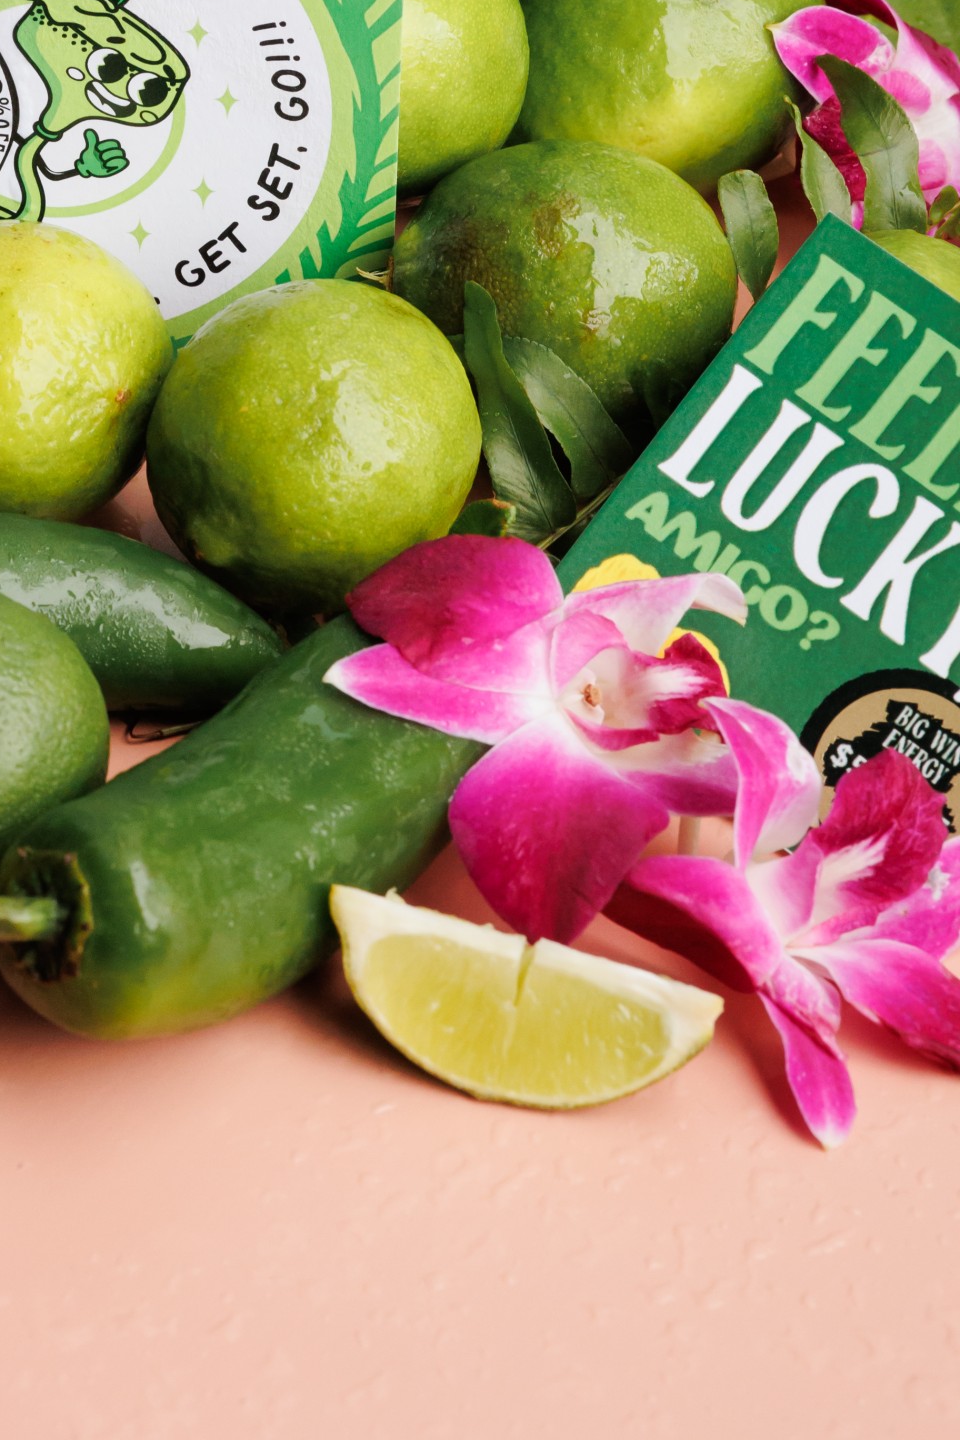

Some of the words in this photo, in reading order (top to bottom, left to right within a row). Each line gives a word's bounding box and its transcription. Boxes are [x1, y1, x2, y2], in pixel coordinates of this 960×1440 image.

[252, 21, 309, 121] GO!!!
[247, 142, 308, 222] SET,
[175, 221, 247, 287] GET
[625, 491, 841, 651] AMIGO?
[882, 728, 951, 785] ENERGY
[894, 704, 930, 739] BIG
